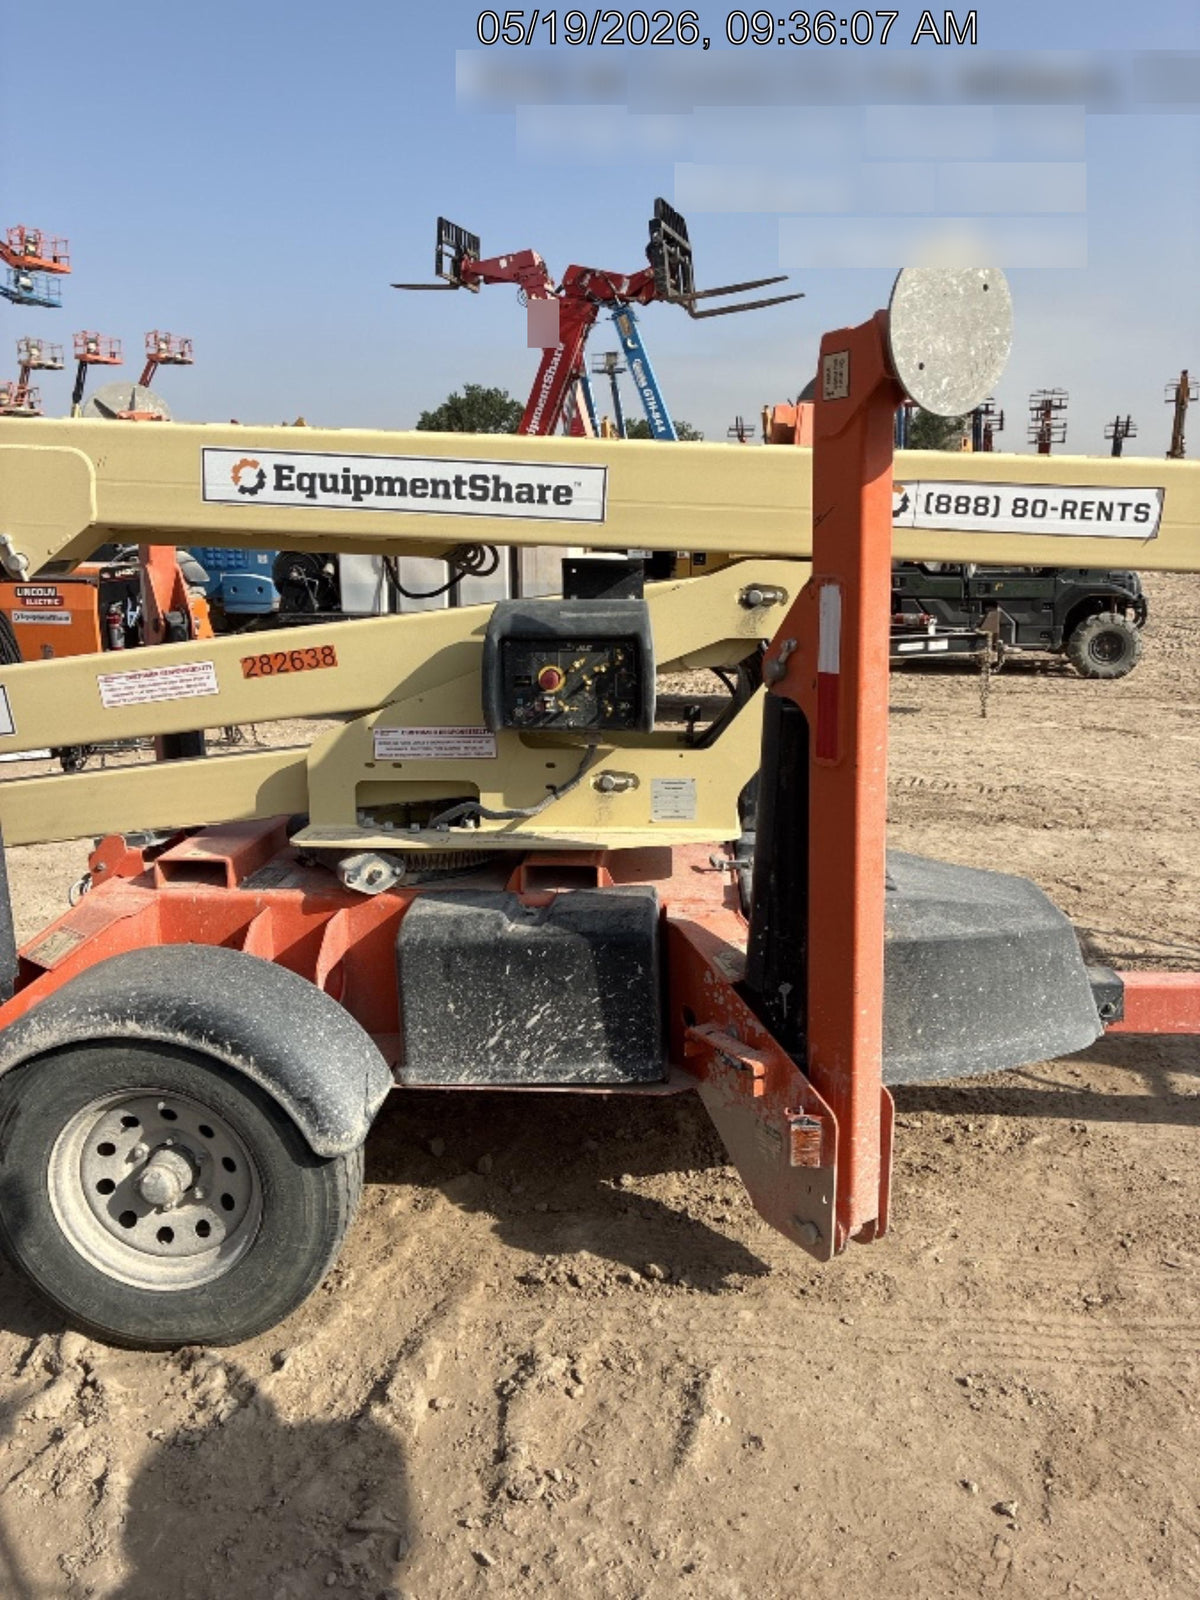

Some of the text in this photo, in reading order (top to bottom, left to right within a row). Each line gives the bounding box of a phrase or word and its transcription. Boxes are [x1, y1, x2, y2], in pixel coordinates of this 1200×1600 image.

[924, 492, 1151, 523] (888) 80-RENTS
[16, 587, 56, 597] LINCOLN
[25, 598, 60, 606] ELECTRIC
[243, 645, 335, 678] 282638
